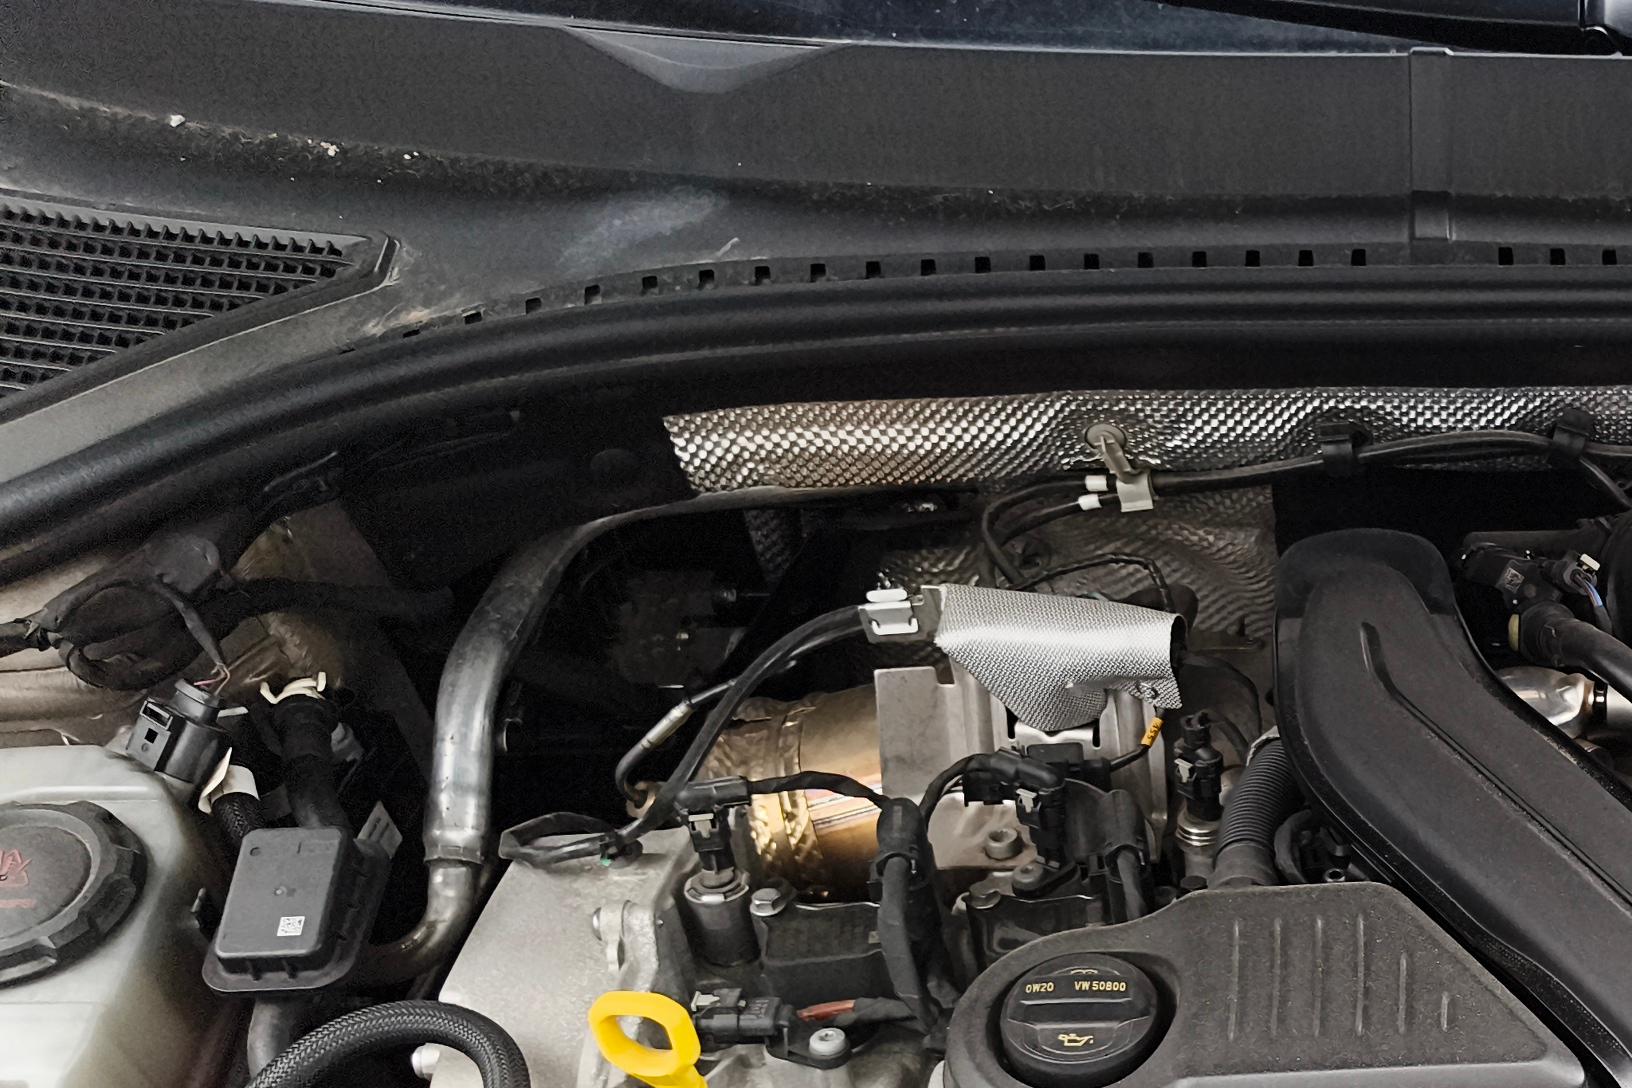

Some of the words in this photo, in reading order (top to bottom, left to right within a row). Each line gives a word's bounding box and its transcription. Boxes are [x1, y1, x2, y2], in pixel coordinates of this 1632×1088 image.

[1025, 982, 1055, 994] 0W20
[1074, 981, 1090, 991] VW
[1092, 981, 1127, 992] 50800
